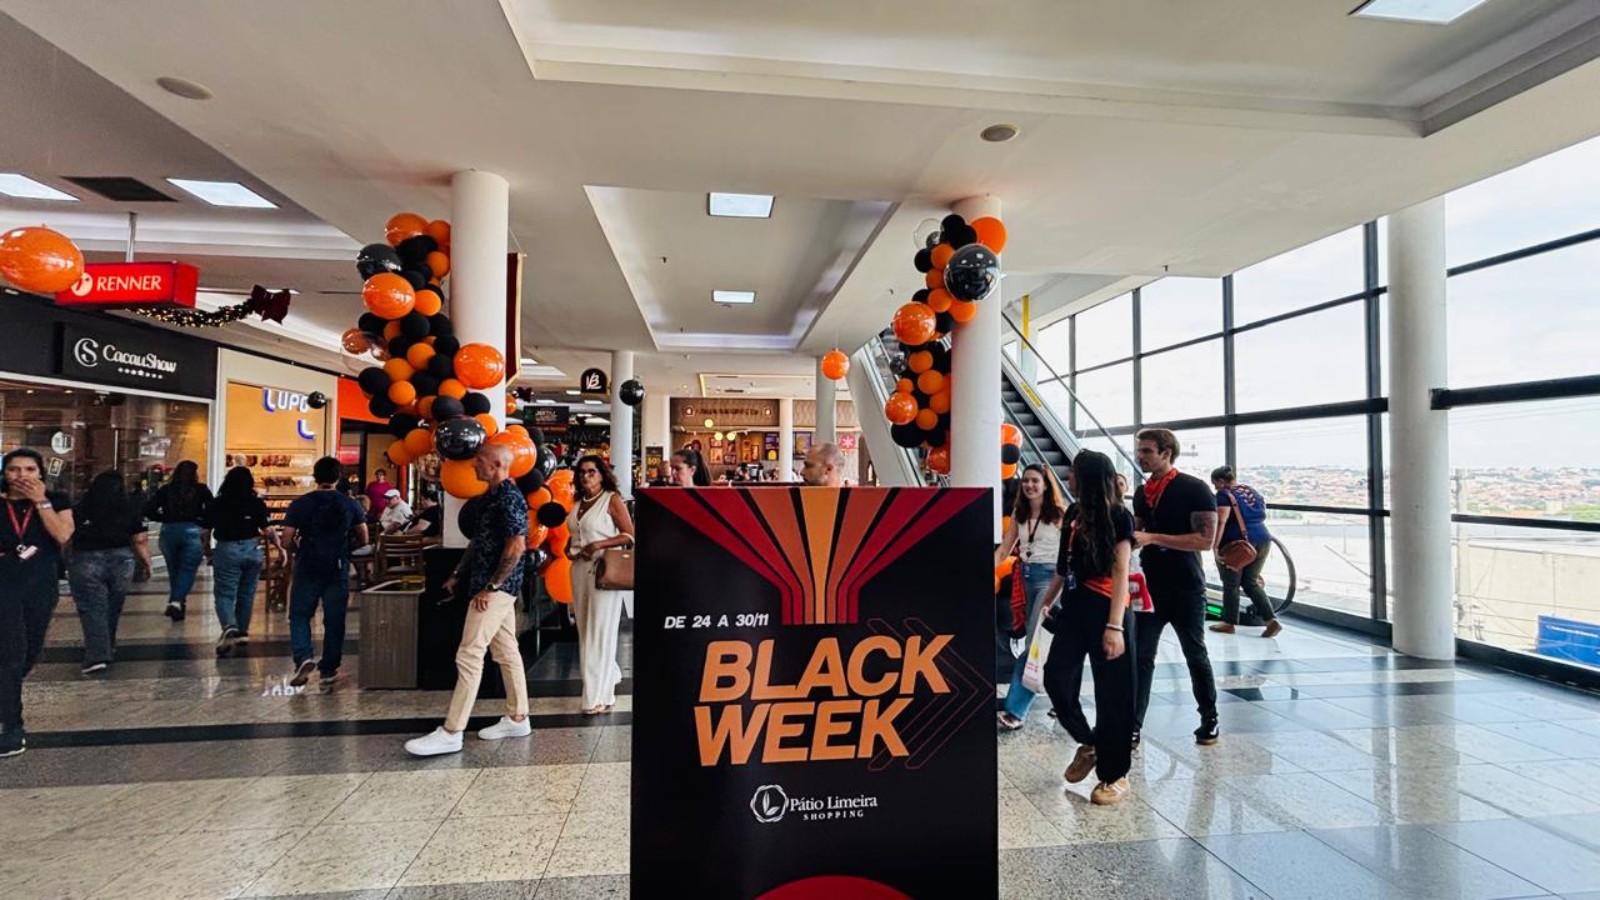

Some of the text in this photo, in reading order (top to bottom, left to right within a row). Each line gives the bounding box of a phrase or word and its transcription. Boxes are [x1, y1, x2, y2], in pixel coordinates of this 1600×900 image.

[96, 275, 162, 291] RENNER
[664, 612, 769, 629] DE 24 A 30/11
[699, 635, 955, 702] BLACK
[694, 698, 914, 767] WEEK
[790, 794, 878, 811] Pátio Limeira
[803, 810, 864, 820] SHOPPING
